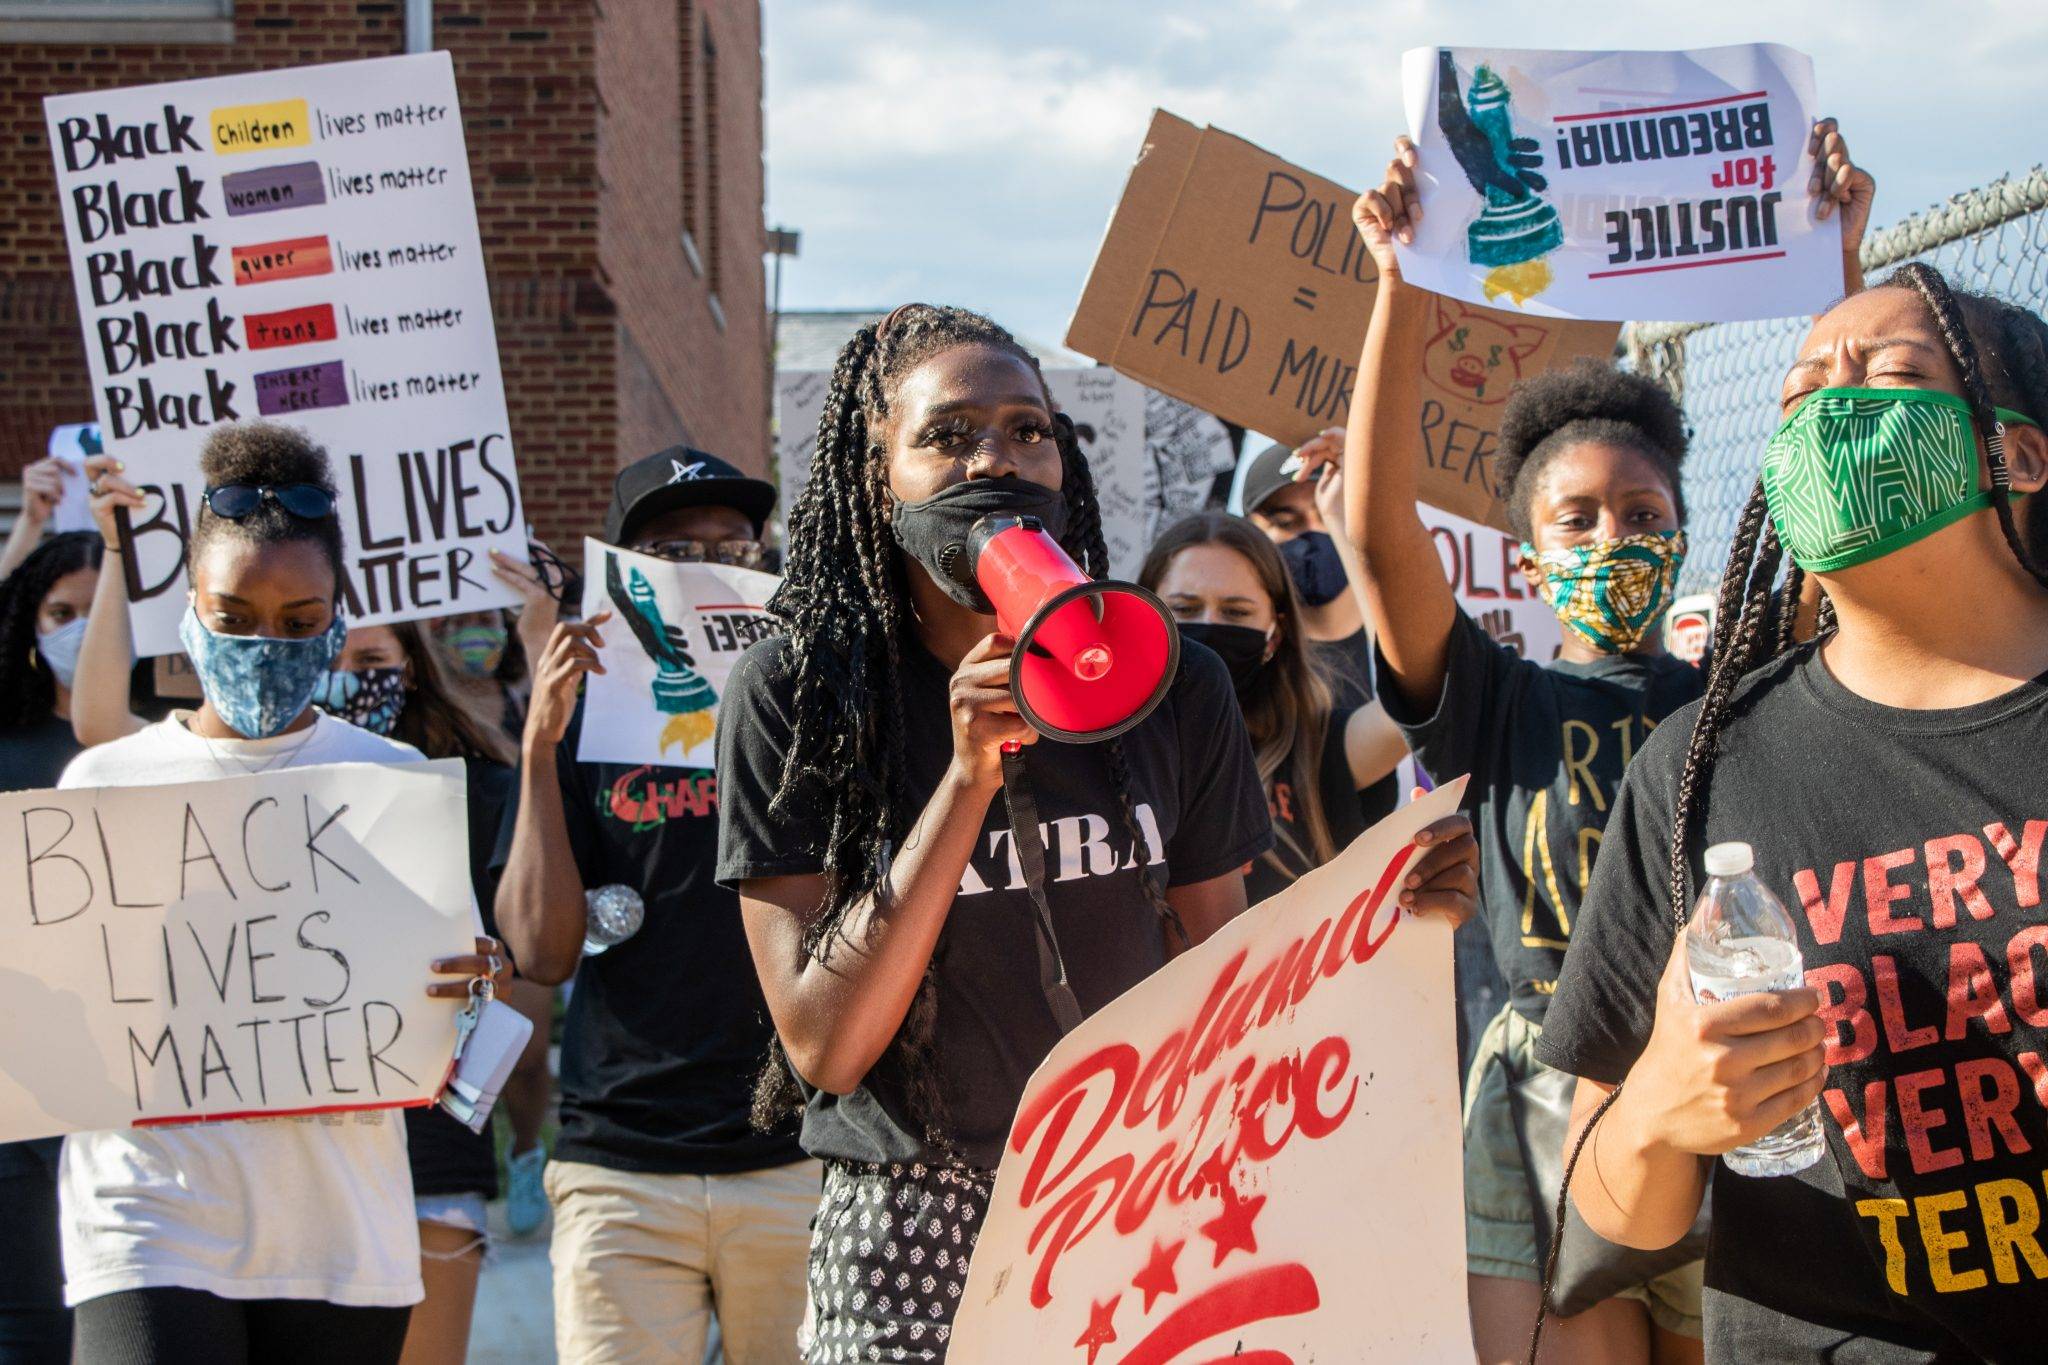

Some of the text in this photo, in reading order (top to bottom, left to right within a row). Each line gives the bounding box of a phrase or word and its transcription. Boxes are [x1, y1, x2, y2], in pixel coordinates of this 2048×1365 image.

[58, 102, 448, 172] Black Children lives matter
[1711, 154, 1777, 191] for
[72, 165, 448, 243] Black women lives matter
[1248, 171, 1381, 284] POLIC
[1604, 191, 1782, 265] JUSTICE
[86, 233, 457, 307] Black queer lives matter
[97, 297, 463, 376] Black trans lives matter
[1132, 268, 1360, 421] PAID MUR
[104, 368, 240, 440] Black
[353, 368, 400, 402] lives
[406, 371, 480, 398] matter
[1420, 399, 1500, 500] PER
[350, 433, 516, 552] LIVES
[342, 547, 488, 620] TTER
[21, 793, 361, 926] BLACK
[1791, 819, 2048, 946] VERY
[100, 909, 352, 1010] LIVES
[1803, 924, 2048, 1067] BLAC
[127, 1000, 419, 1112] MATTER
[1012, 842, 1416, 1210] Defund
[1854, 1168, 2048, 1297] TER
